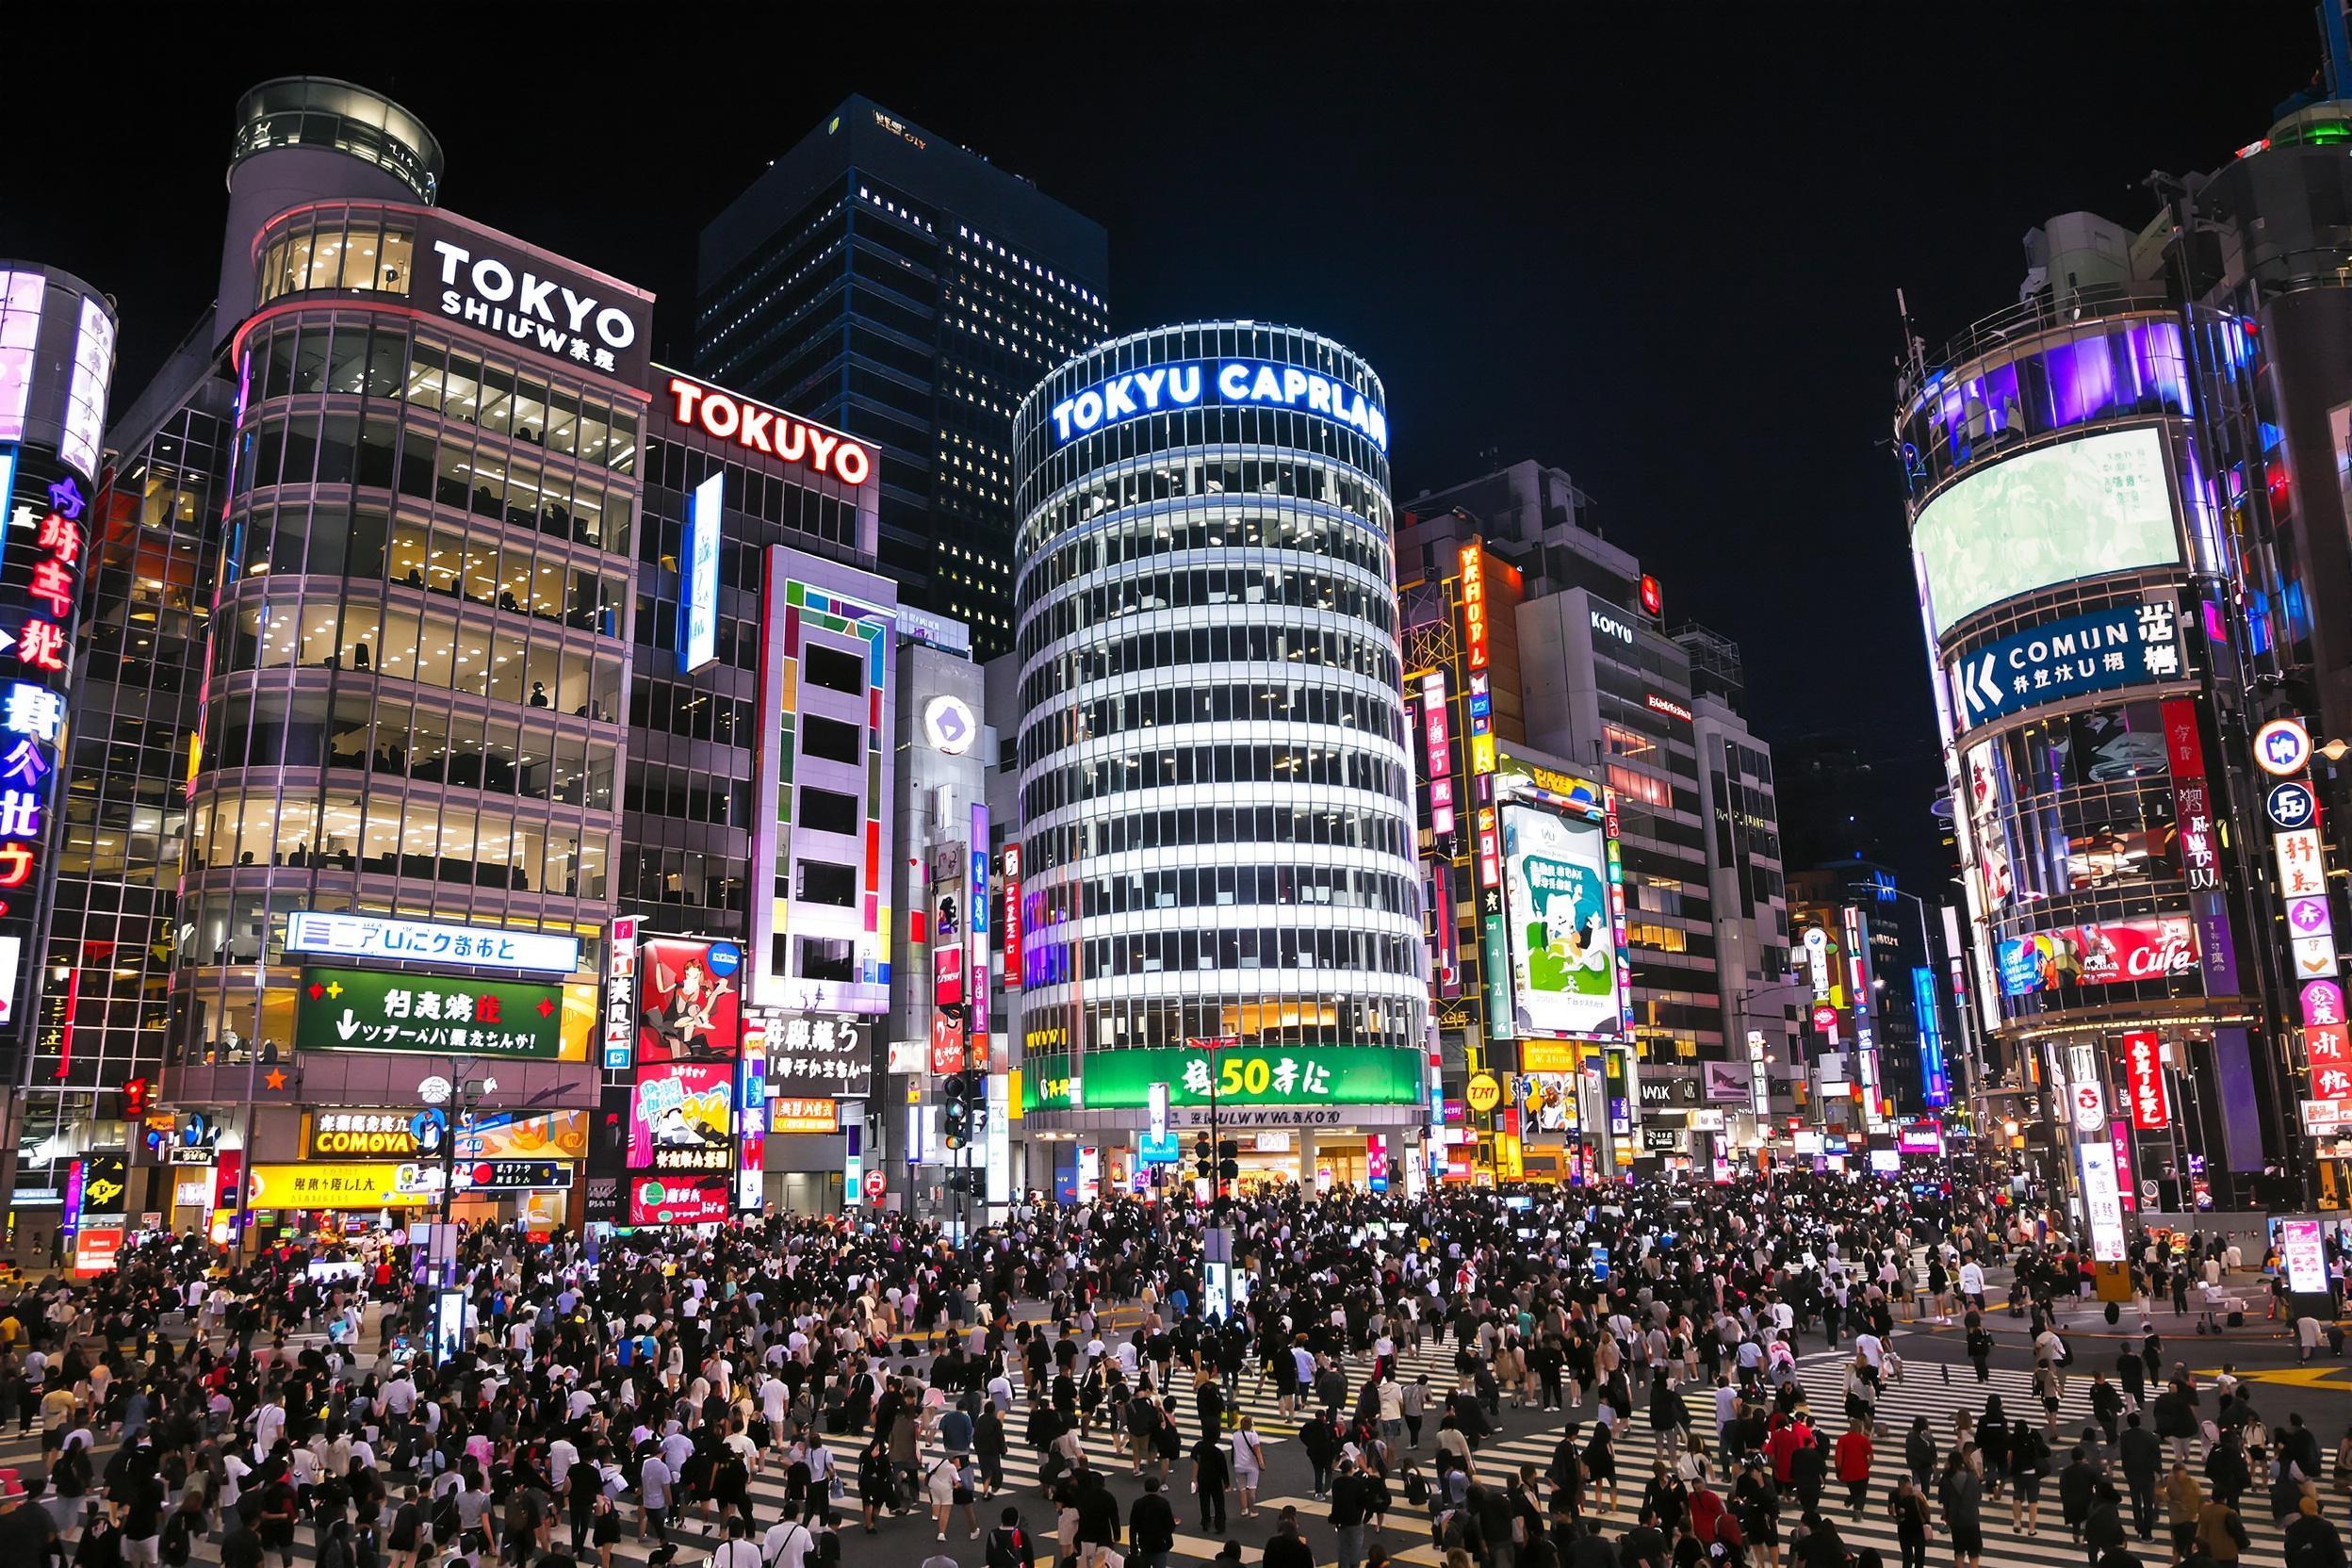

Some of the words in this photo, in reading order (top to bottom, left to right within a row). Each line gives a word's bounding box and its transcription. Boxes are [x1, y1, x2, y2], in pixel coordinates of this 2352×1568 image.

[434, 240, 635, 349] TOKYO
[669, 378, 871, 485] TOKUYO
[1053, 366, 1200, 441] TOKYU
[2009, 622, 2129, 669] COMUN
[1220, 1058, 1270, 1095] 50
[317, 1132, 409, 1152] COMOYA
